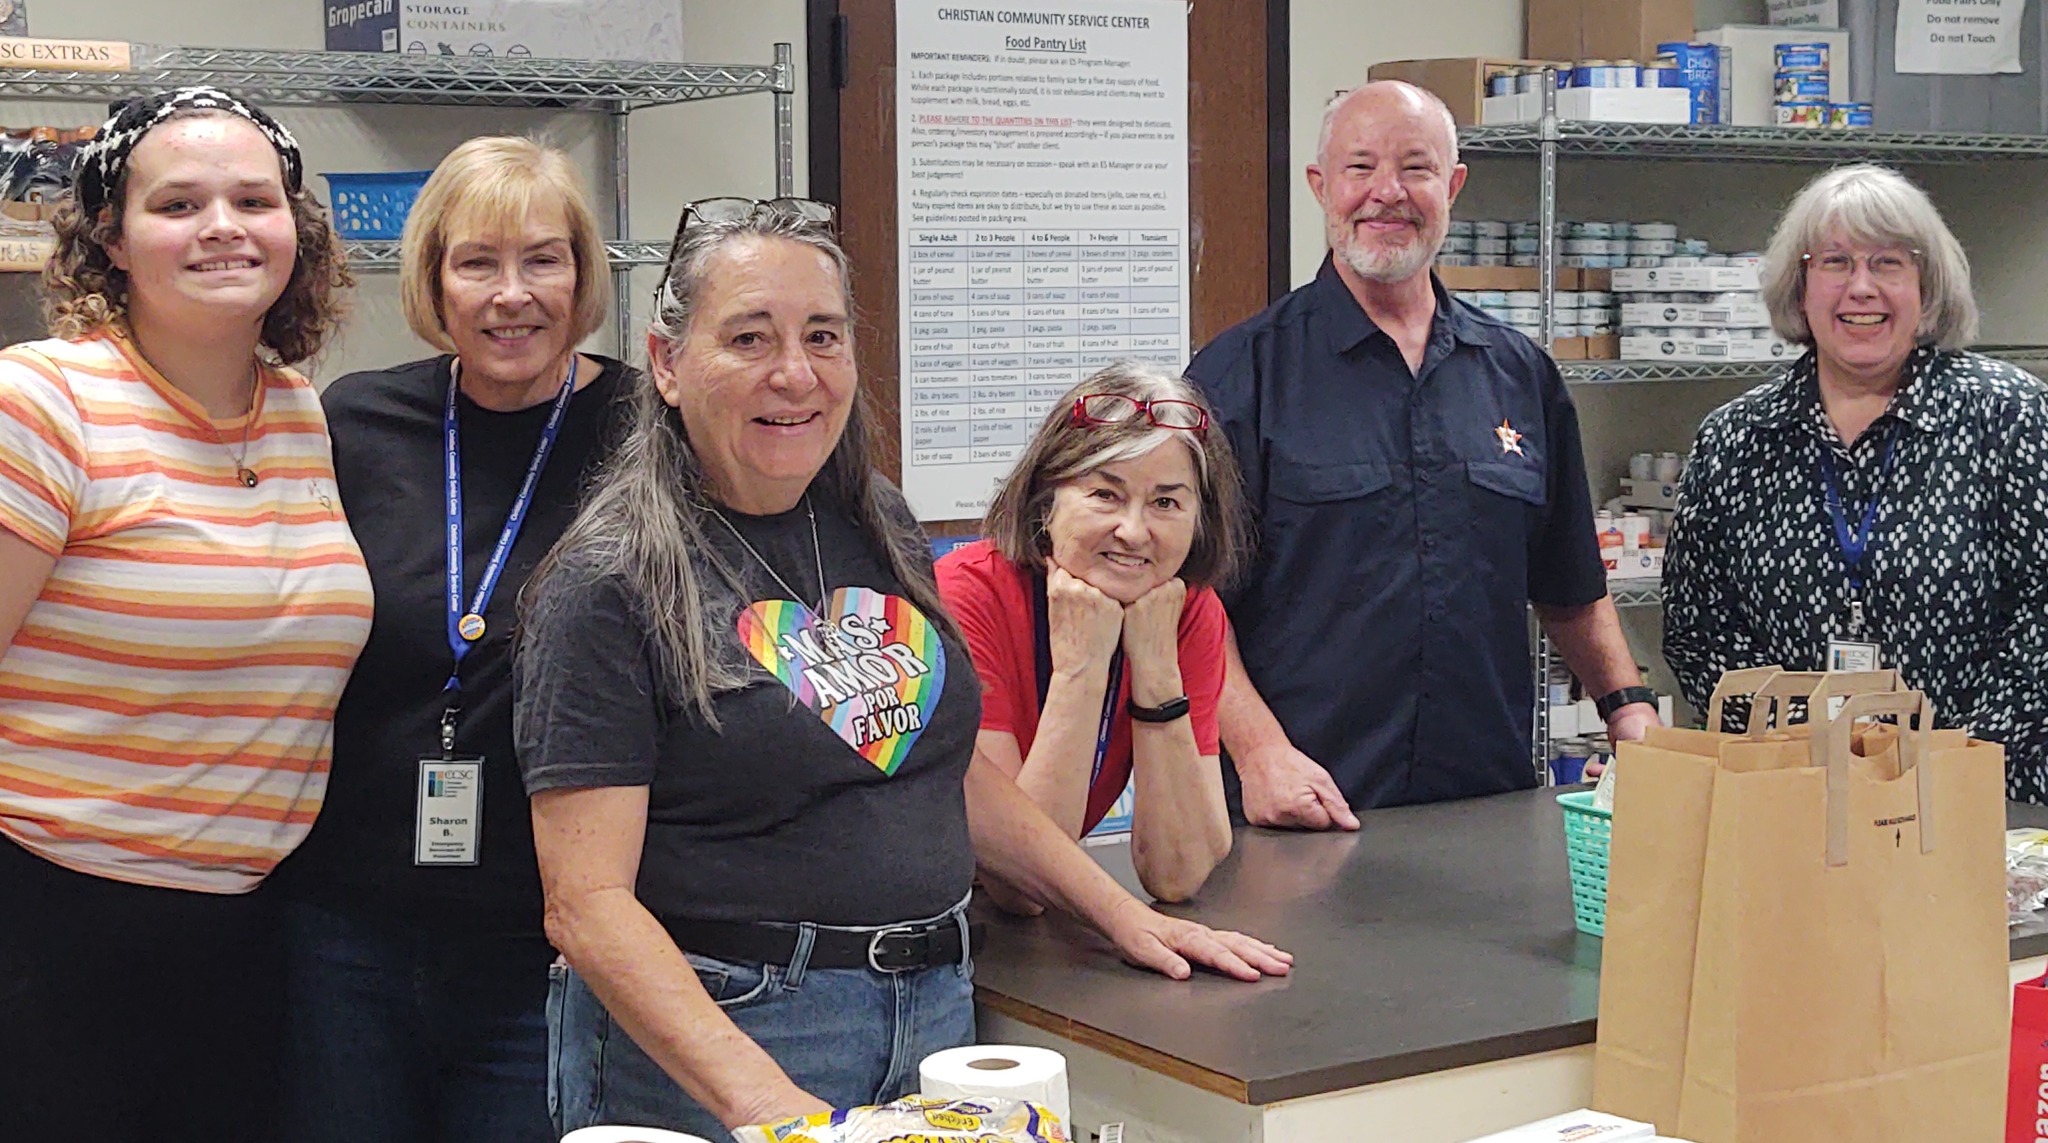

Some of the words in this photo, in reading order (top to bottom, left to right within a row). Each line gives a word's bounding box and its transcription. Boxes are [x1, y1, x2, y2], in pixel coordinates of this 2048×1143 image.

[407, 5, 469, 15] STORAGE
[938, 9, 994, 22] CHRISTIAN
[997, 11, 1065, 25] COMMUNITY
[1068, 14, 1109, 27] SERVICE
[1111, 15, 1150, 29] CENTER
[1927, 14, 1941, 23] Do
[1963, 16, 1999, 24] remove
[407, 20, 506, 32] CONTAINERS
[1930, 33, 1944, 43] Do
[1948, 34, 1963, 43] not
[1968, 34, 1995, 43] Touch
[1005, 36, 1031, 48] Food
[1034, 37, 1067, 52] Pantry
[1069, 38, 1086, 51] List
[32, 44, 110, 61] EXTRAS
[911, 52, 950, 61] IMPORTANT
[919, 234, 938, 243] Single
[995, 234, 1015, 243] People
[1050, 234, 1070, 243] People
[1098, 234, 1119, 243] People
[803, 642, 931, 709] AMOR
[862, 686, 900, 714] POR
[852, 702, 922, 747] FAVOR
[429, 817, 468, 825] Sharon
[443, 829, 454, 837] B.
[932, 1113, 974, 1127] Enriched
